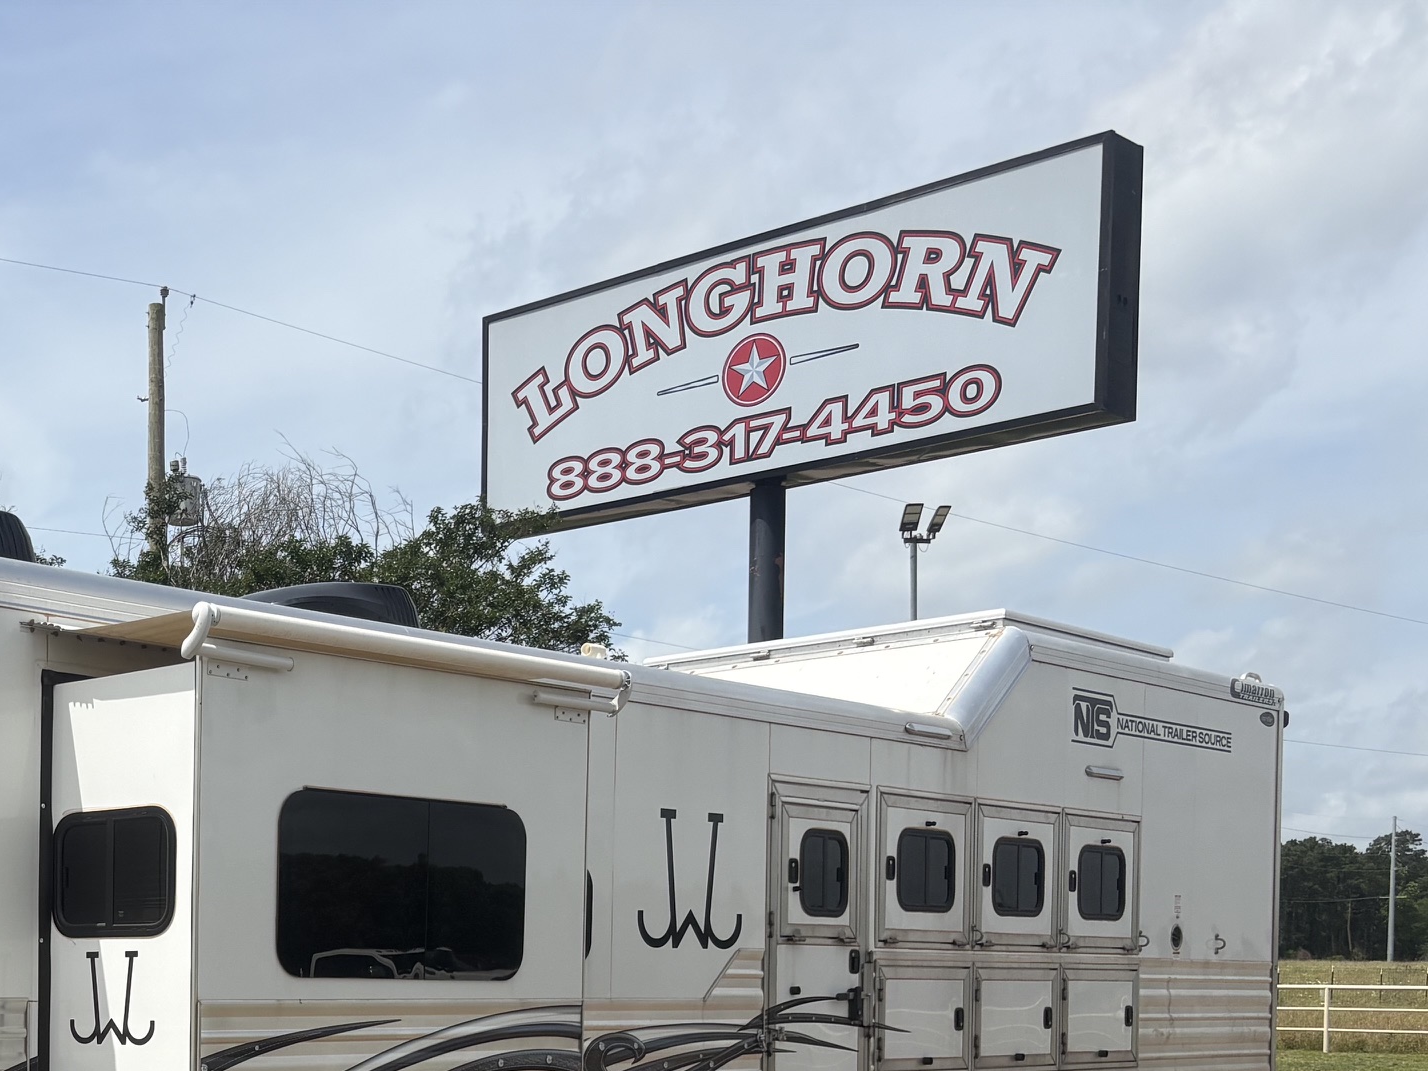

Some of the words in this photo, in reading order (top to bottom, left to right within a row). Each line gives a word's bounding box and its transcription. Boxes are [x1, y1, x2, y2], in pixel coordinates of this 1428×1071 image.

[512, 229, 1061, 443] LONGHORN
[546, 363, 1002, 500] 888-317-4450
[1072, 693, 1113, 741] NTS
[1116, 717, 1161, 737] NATIONAL
[1161, 725, 1197, 743] TRAILER
[1198, 733, 1232, 748] SOURCE
